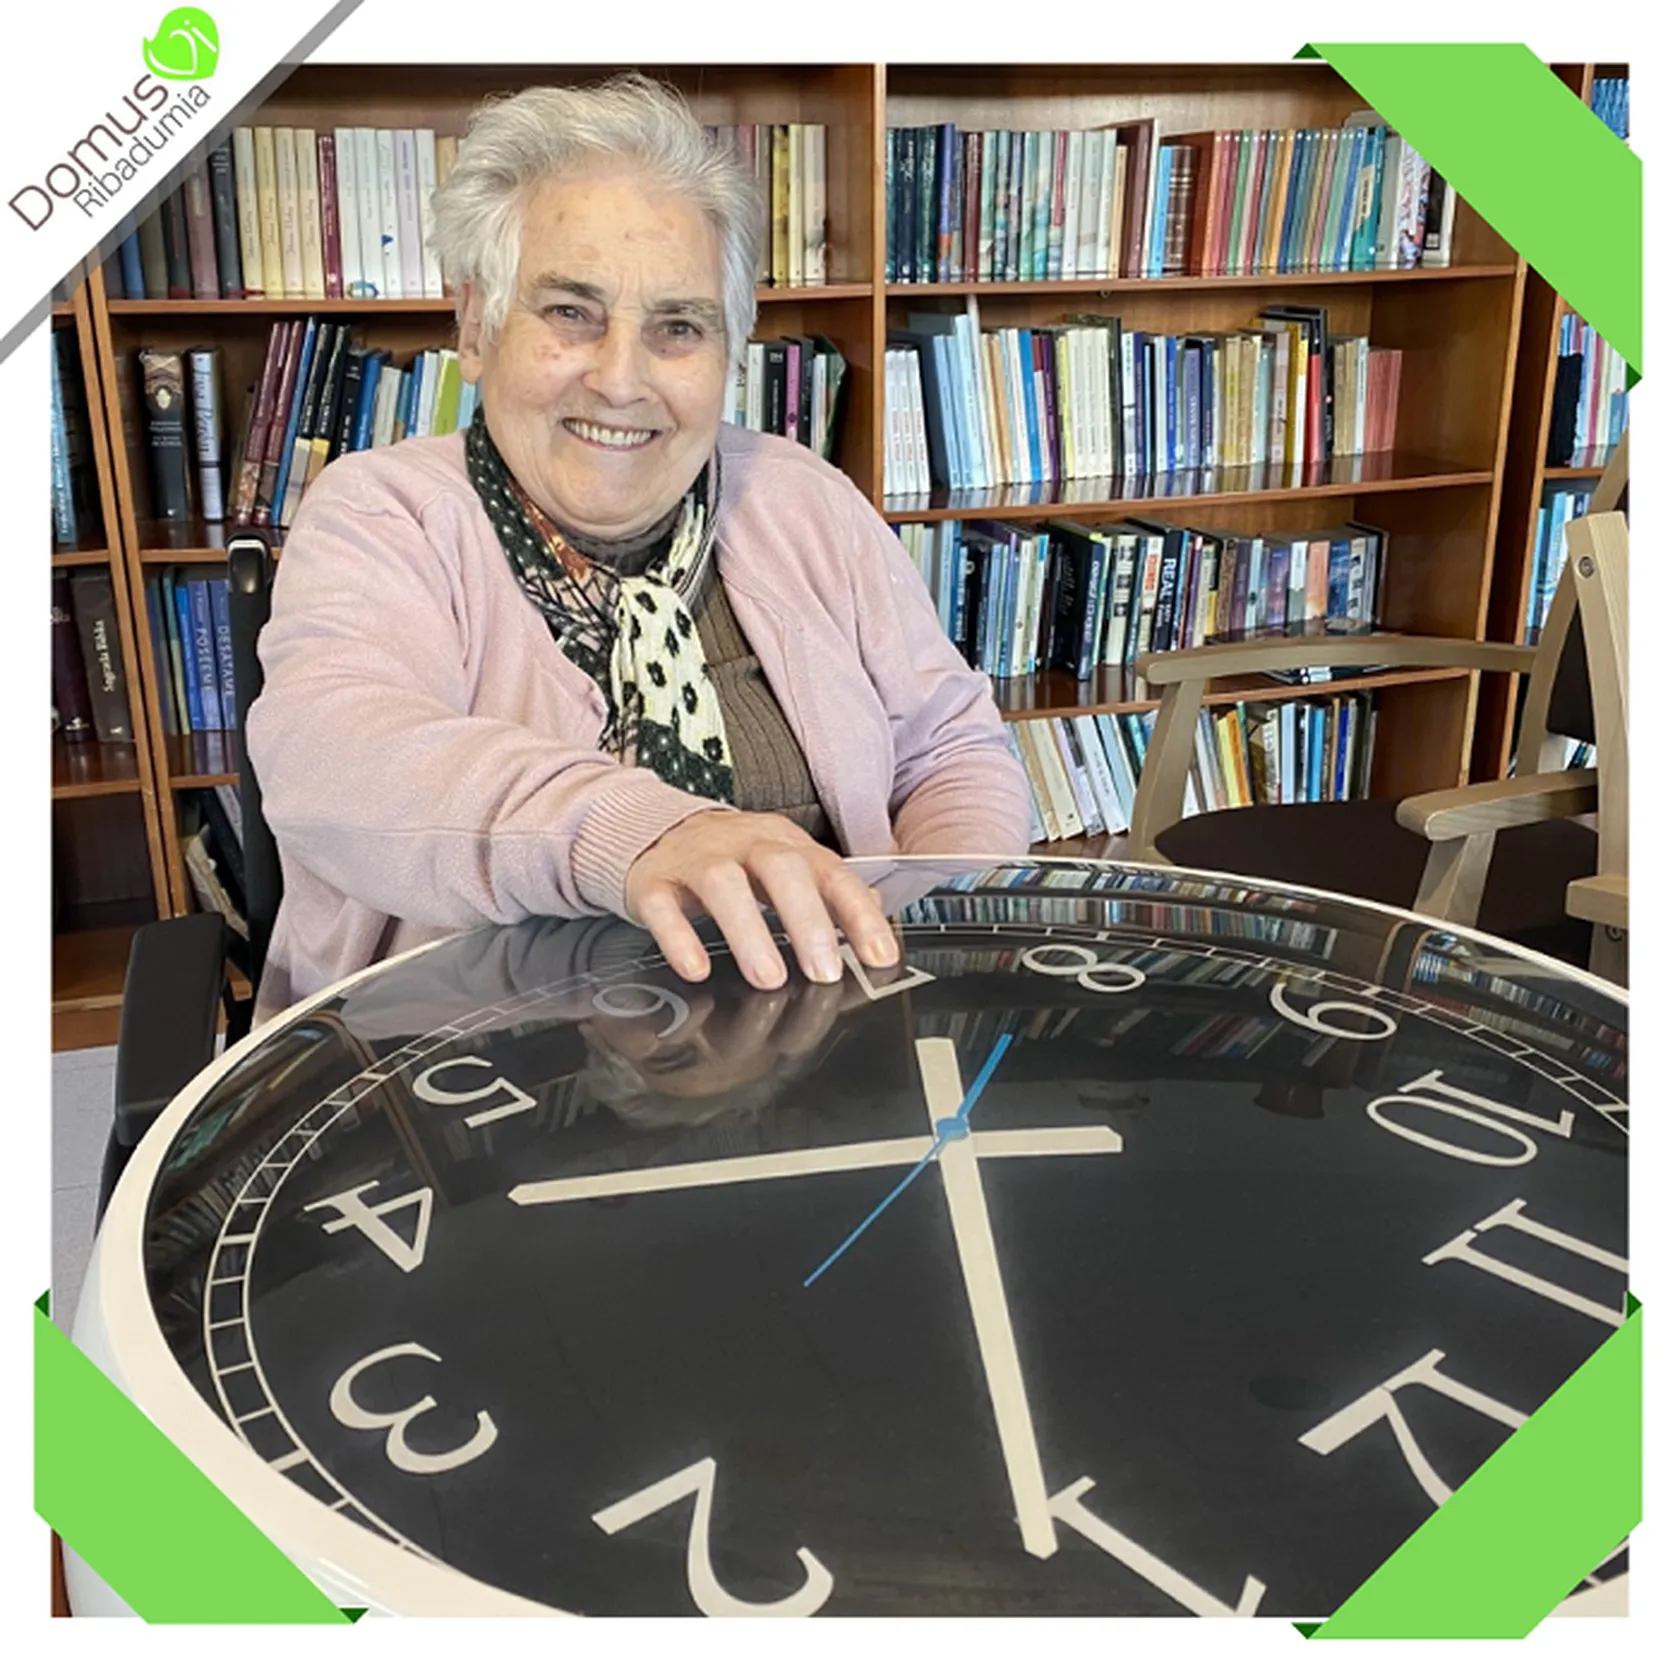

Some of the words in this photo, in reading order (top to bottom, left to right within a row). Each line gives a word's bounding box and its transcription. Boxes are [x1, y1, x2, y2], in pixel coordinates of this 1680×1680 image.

[1159, 558, 1177, 601] REAL
[1021, 943, 1146, 993] 8
[592, 983, 690, 1039] 6
[1269, 982, 1397, 1041] 9
[411, 1055, 538, 1129] 5
[1366, 1069, 1575, 1168] 10
[302, 1178, 433, 1273] 4
[329, 1342, 498, 1475] 3
[591, 1456, 834, 1617] 2
